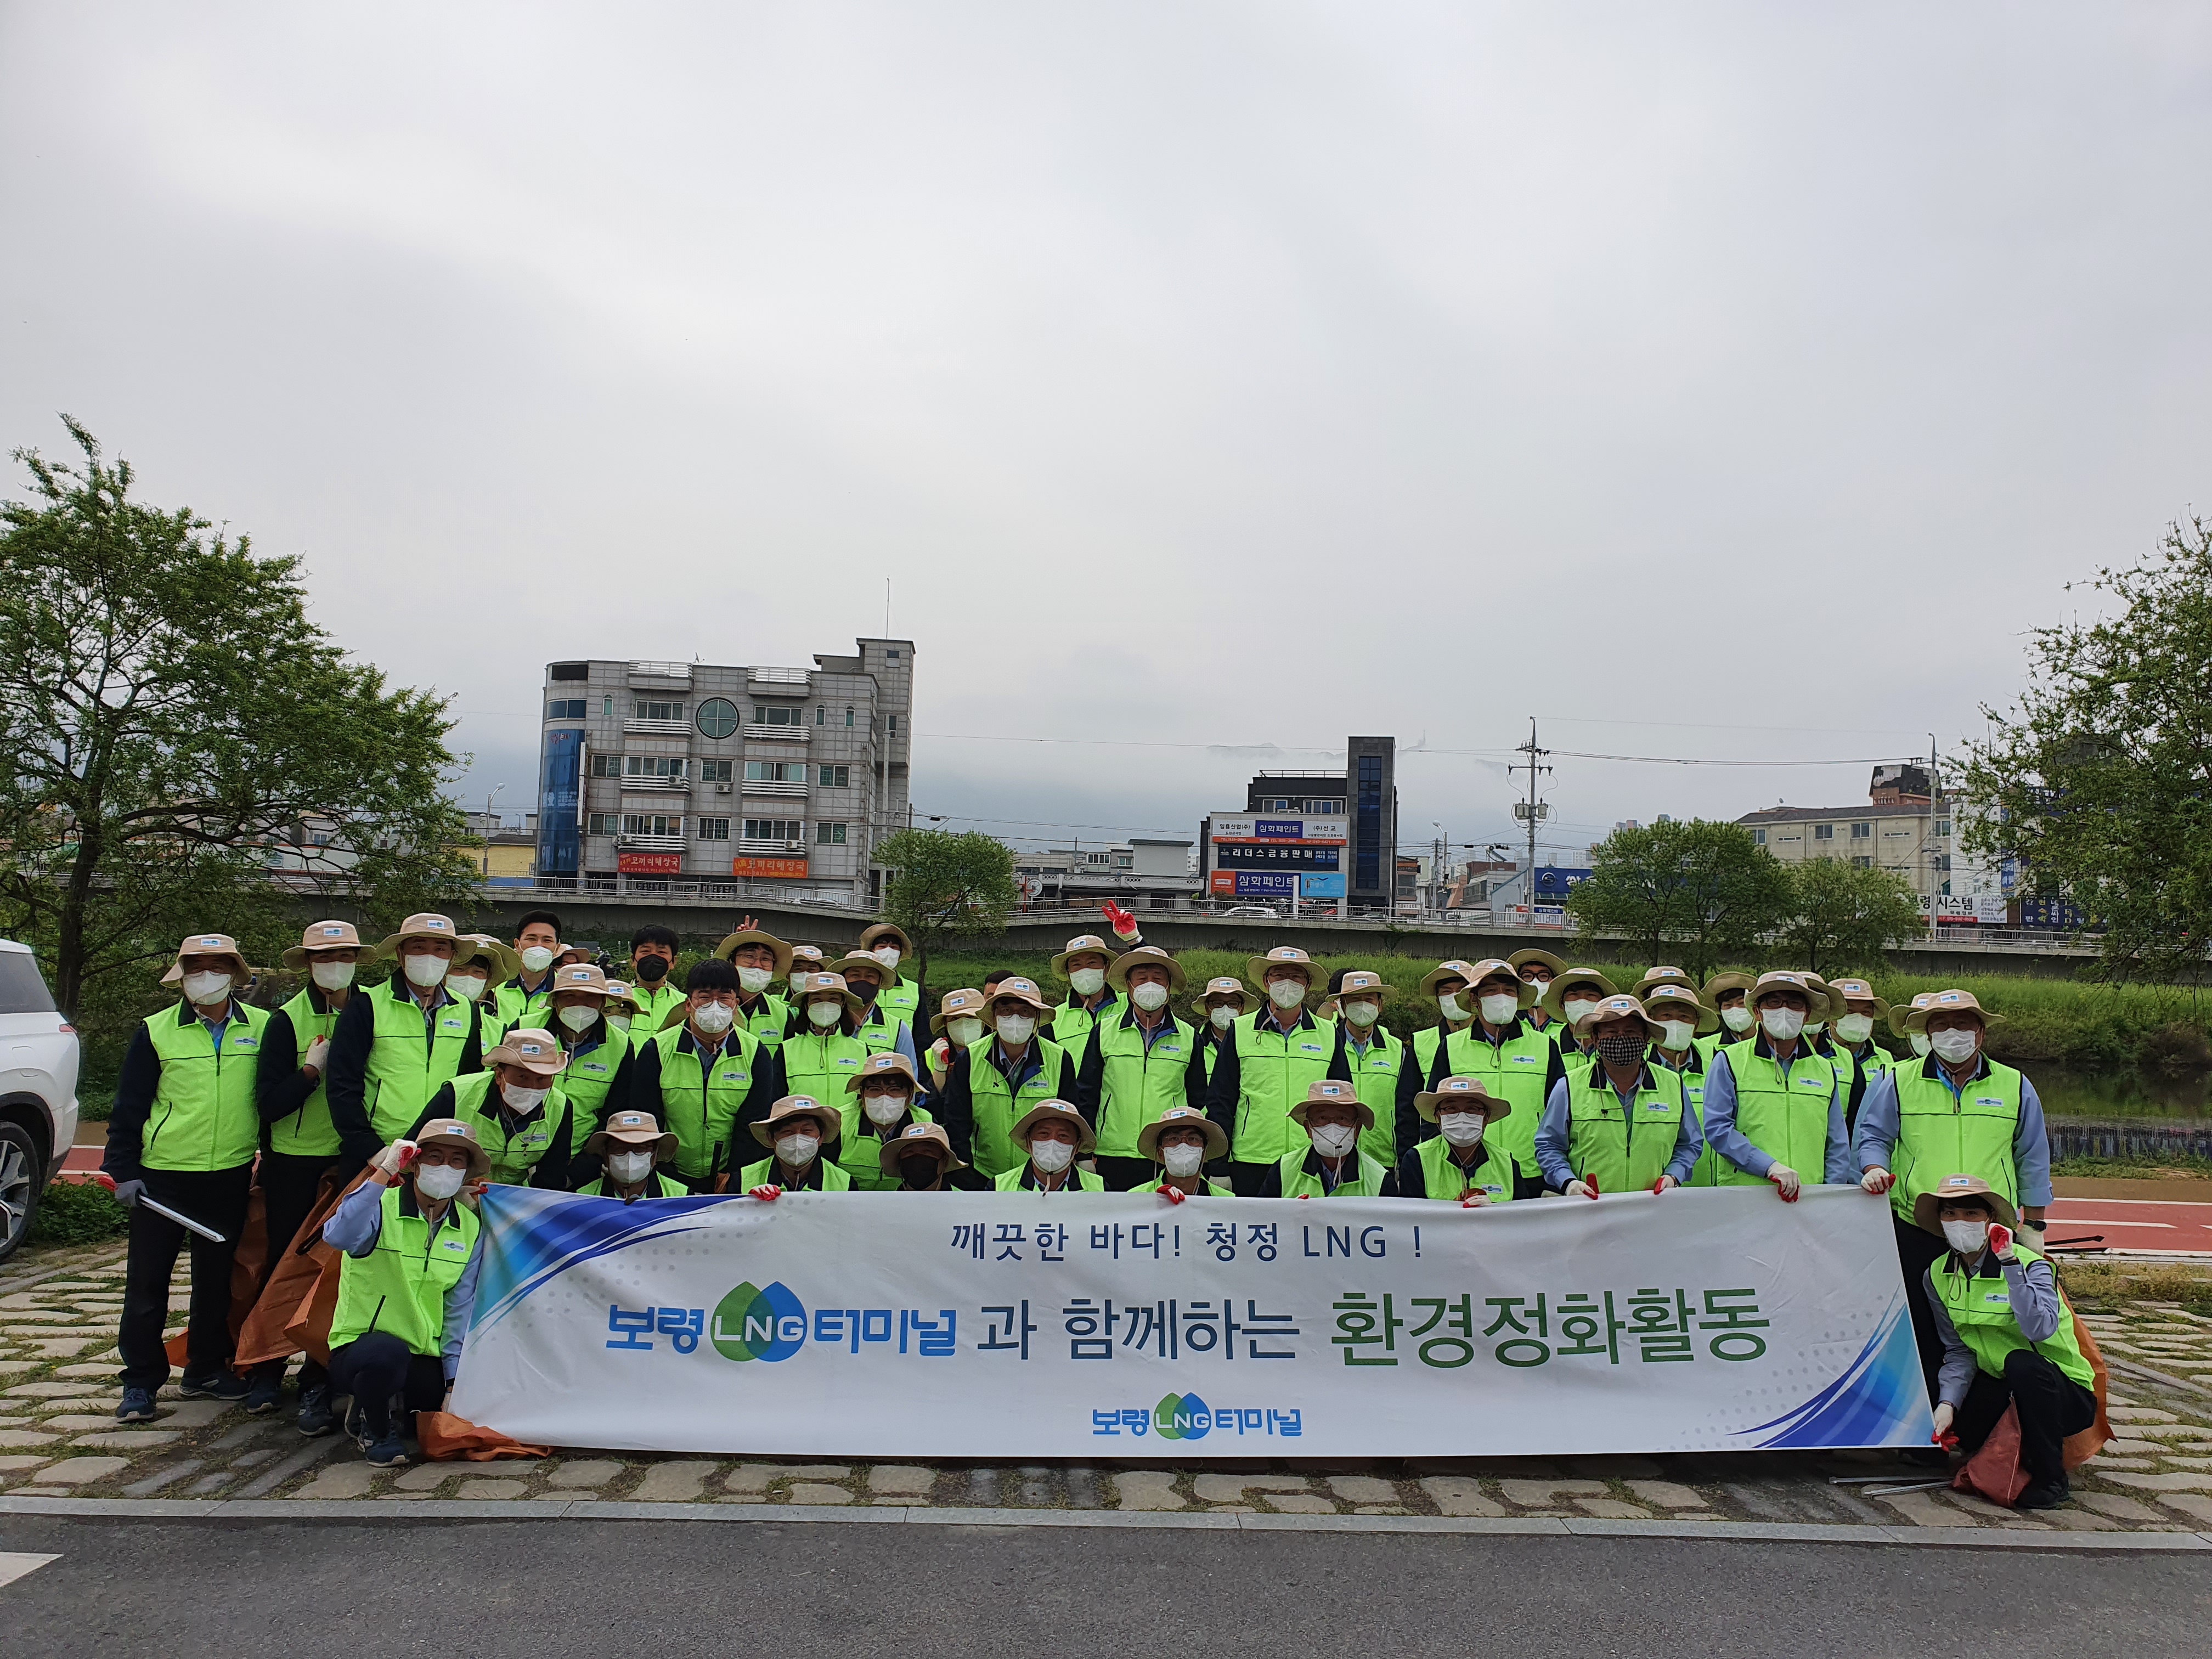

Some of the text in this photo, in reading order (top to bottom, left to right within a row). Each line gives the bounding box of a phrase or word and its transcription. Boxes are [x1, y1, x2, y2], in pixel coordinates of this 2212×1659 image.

[1259, 825, 1299, 833] 삼화페인트
[1232, 849, 1312, 859] 리더스금융판매
[631, 856, 679, 867] 코끼리해장국
[747, 859, 805, 872] 코끼리해장국
[1239, 876, 1293, 887] 삼화페인트
[951, 1223, 1069, 1261] 깨끗한
[1091, 1222, 1180, 1260] 바다!
[1206, 1222, 1278, 1261] 청정
[1304, 1226, 1386, 1258] LNG
[977, 1299, 1037, 1360] 과
[1063, 1299, 1300, 1360] 함께하는
[1331, 1288, 1770, 1368] 환경정화활동
